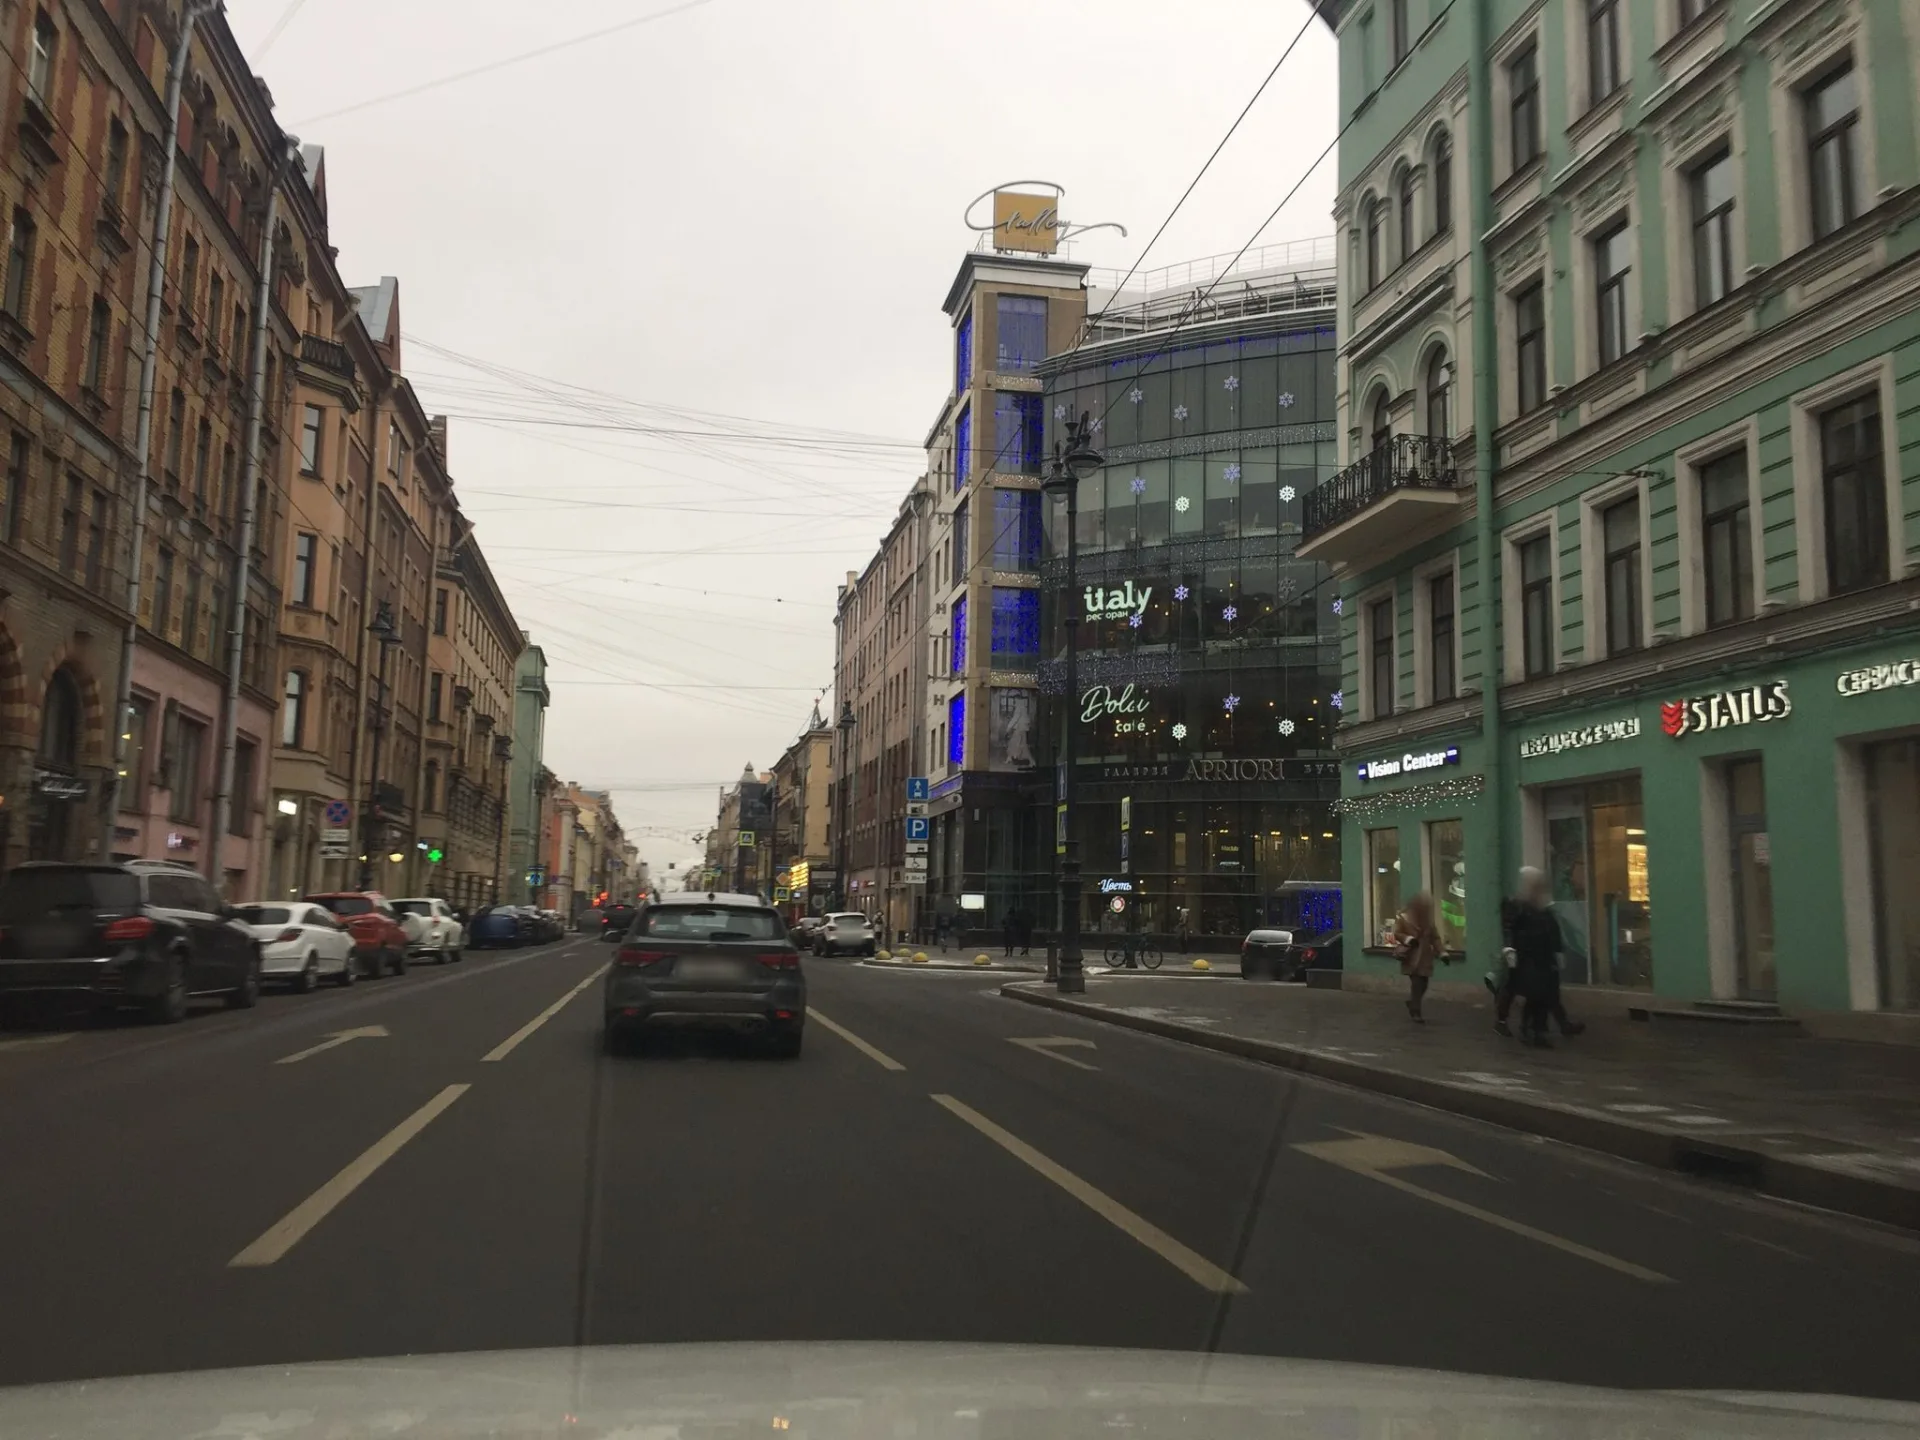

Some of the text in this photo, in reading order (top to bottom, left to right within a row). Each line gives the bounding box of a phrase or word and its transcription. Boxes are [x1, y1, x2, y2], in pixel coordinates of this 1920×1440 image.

[1085, 610, 1128, 623] ресоран
[1691, 680, 1791, 732] STATUS
[1184, 758, 1285, 781] APRIORI
[1367, 752, 1446, 778] Vision Center
[912, 820, 925, 837] P
